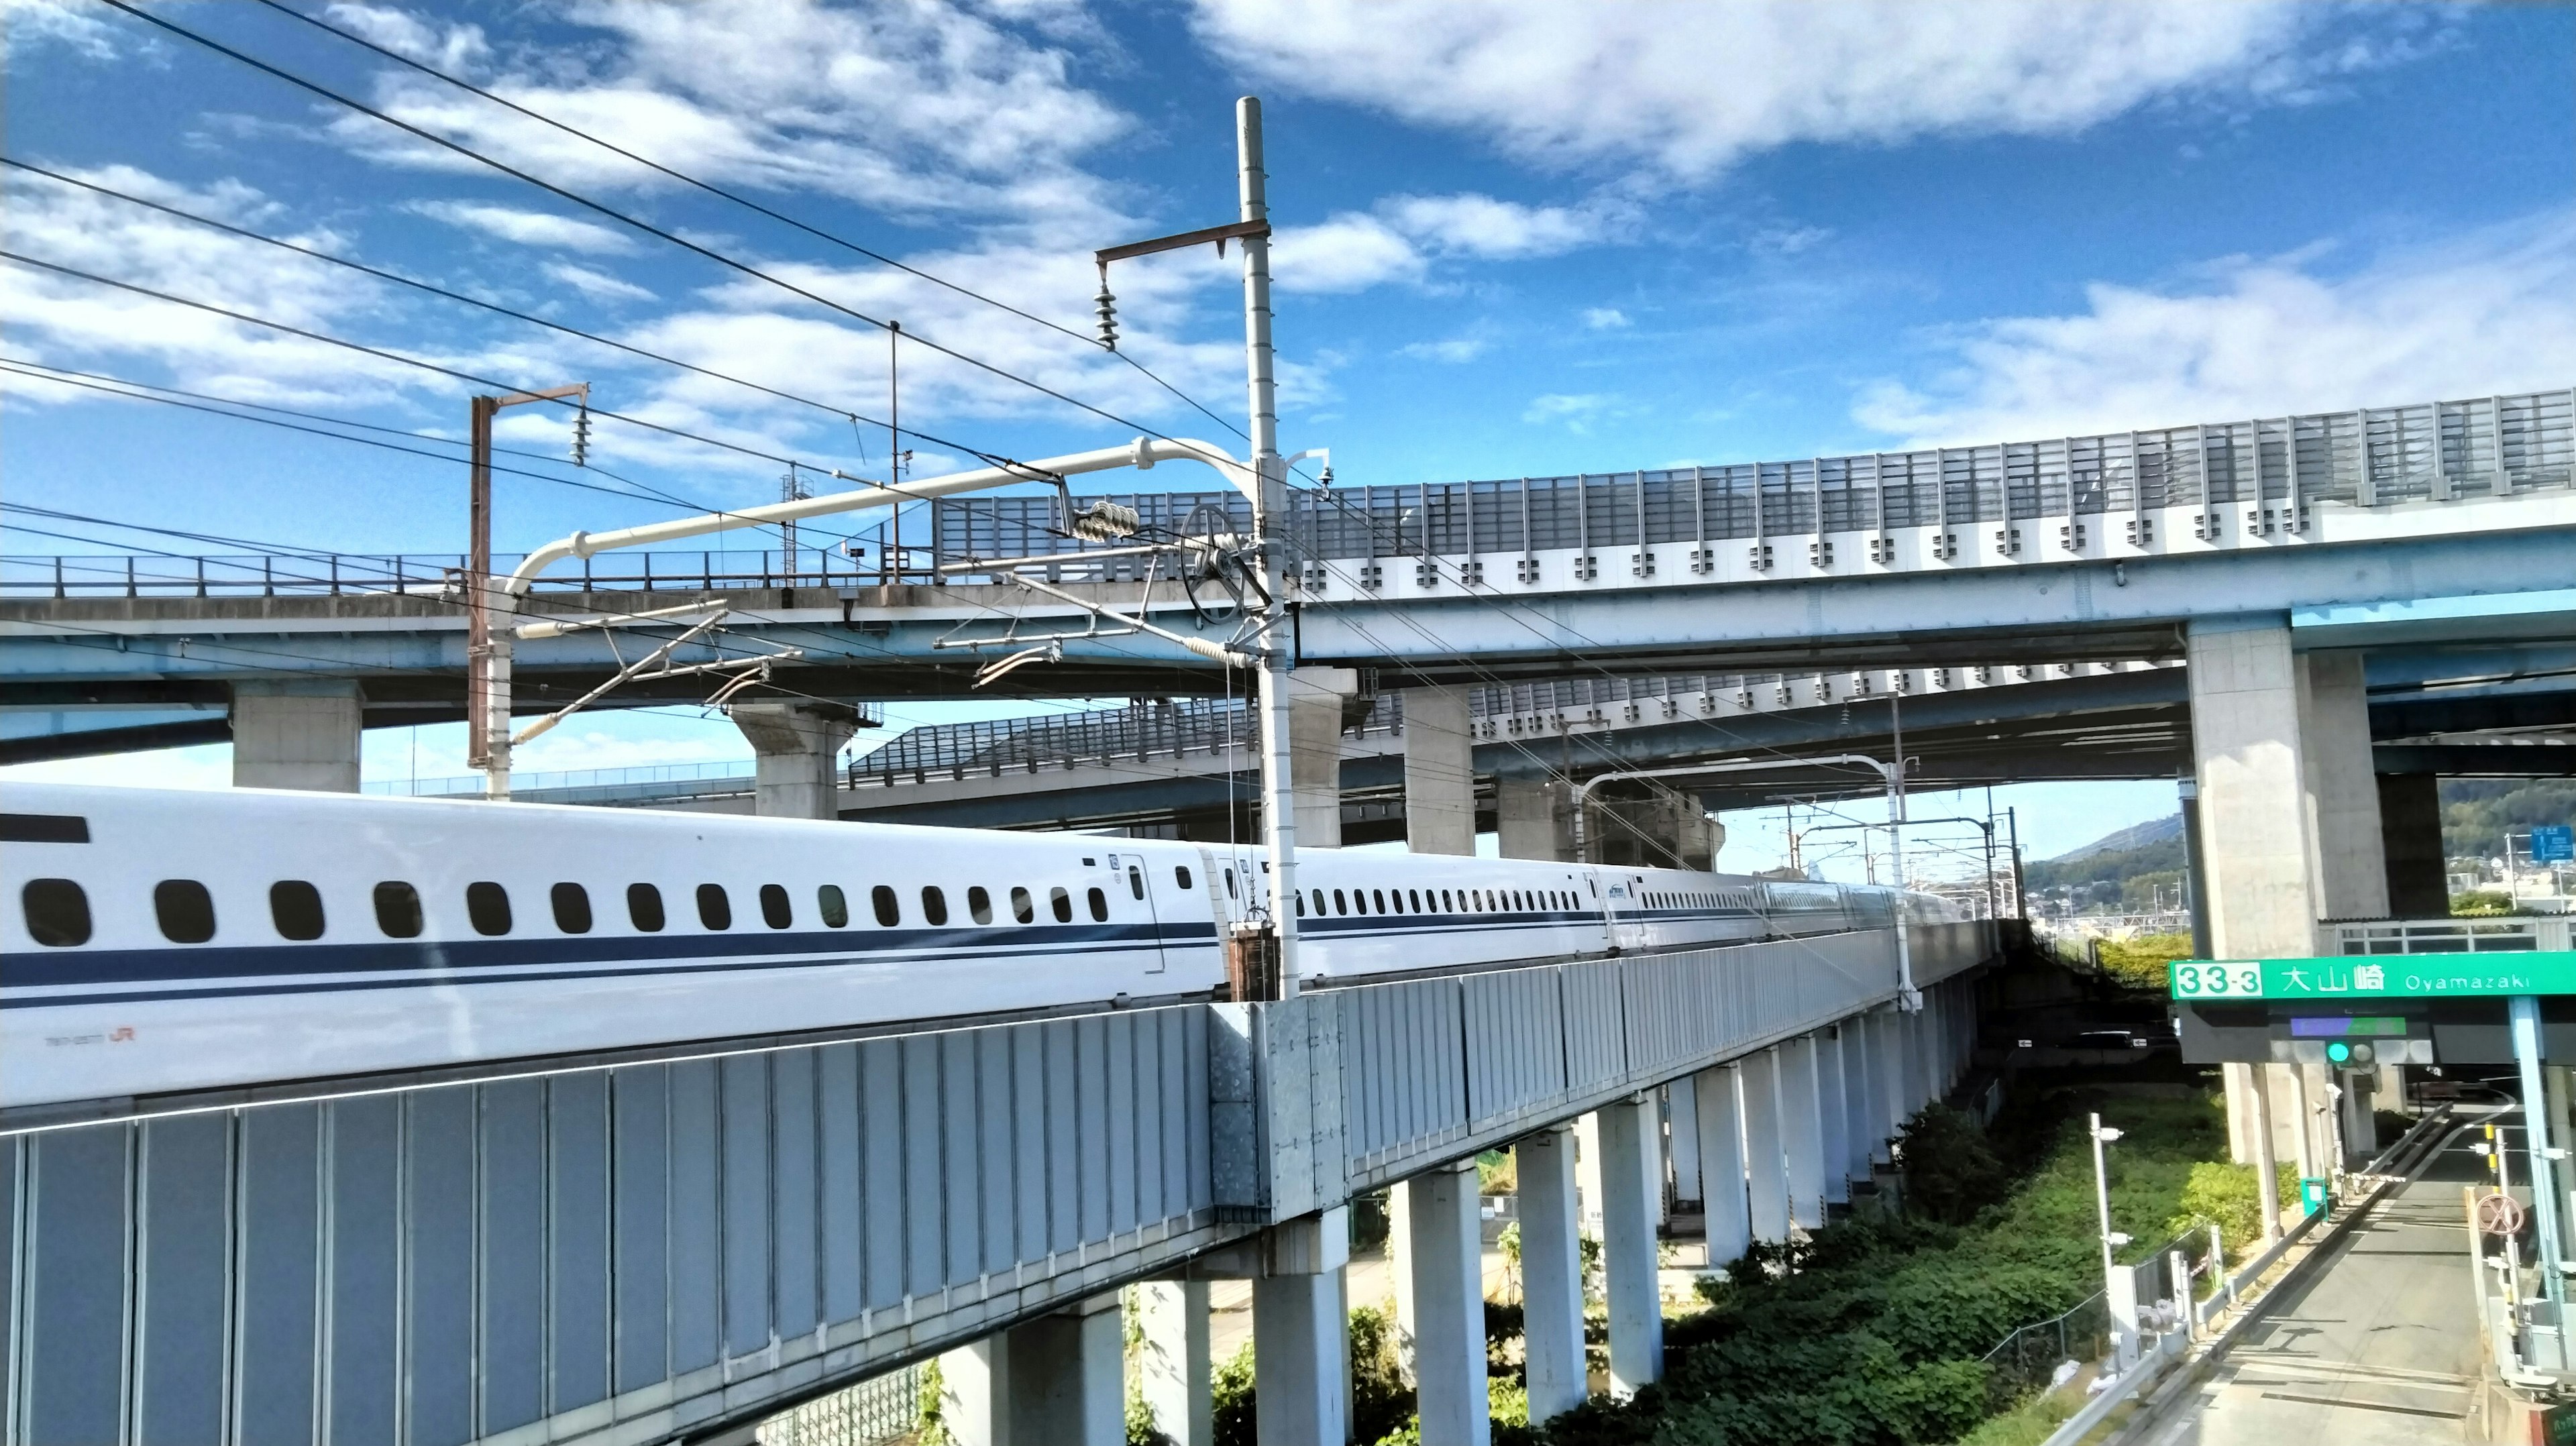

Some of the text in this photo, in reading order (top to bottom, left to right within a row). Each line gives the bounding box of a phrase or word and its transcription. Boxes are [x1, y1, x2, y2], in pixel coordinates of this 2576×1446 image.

[2180, 966, 2259, 993] 33-3
[2281, 964, 2385, 991] 大山崎
[2405, 973, 2530, 993] Oyamazaki
